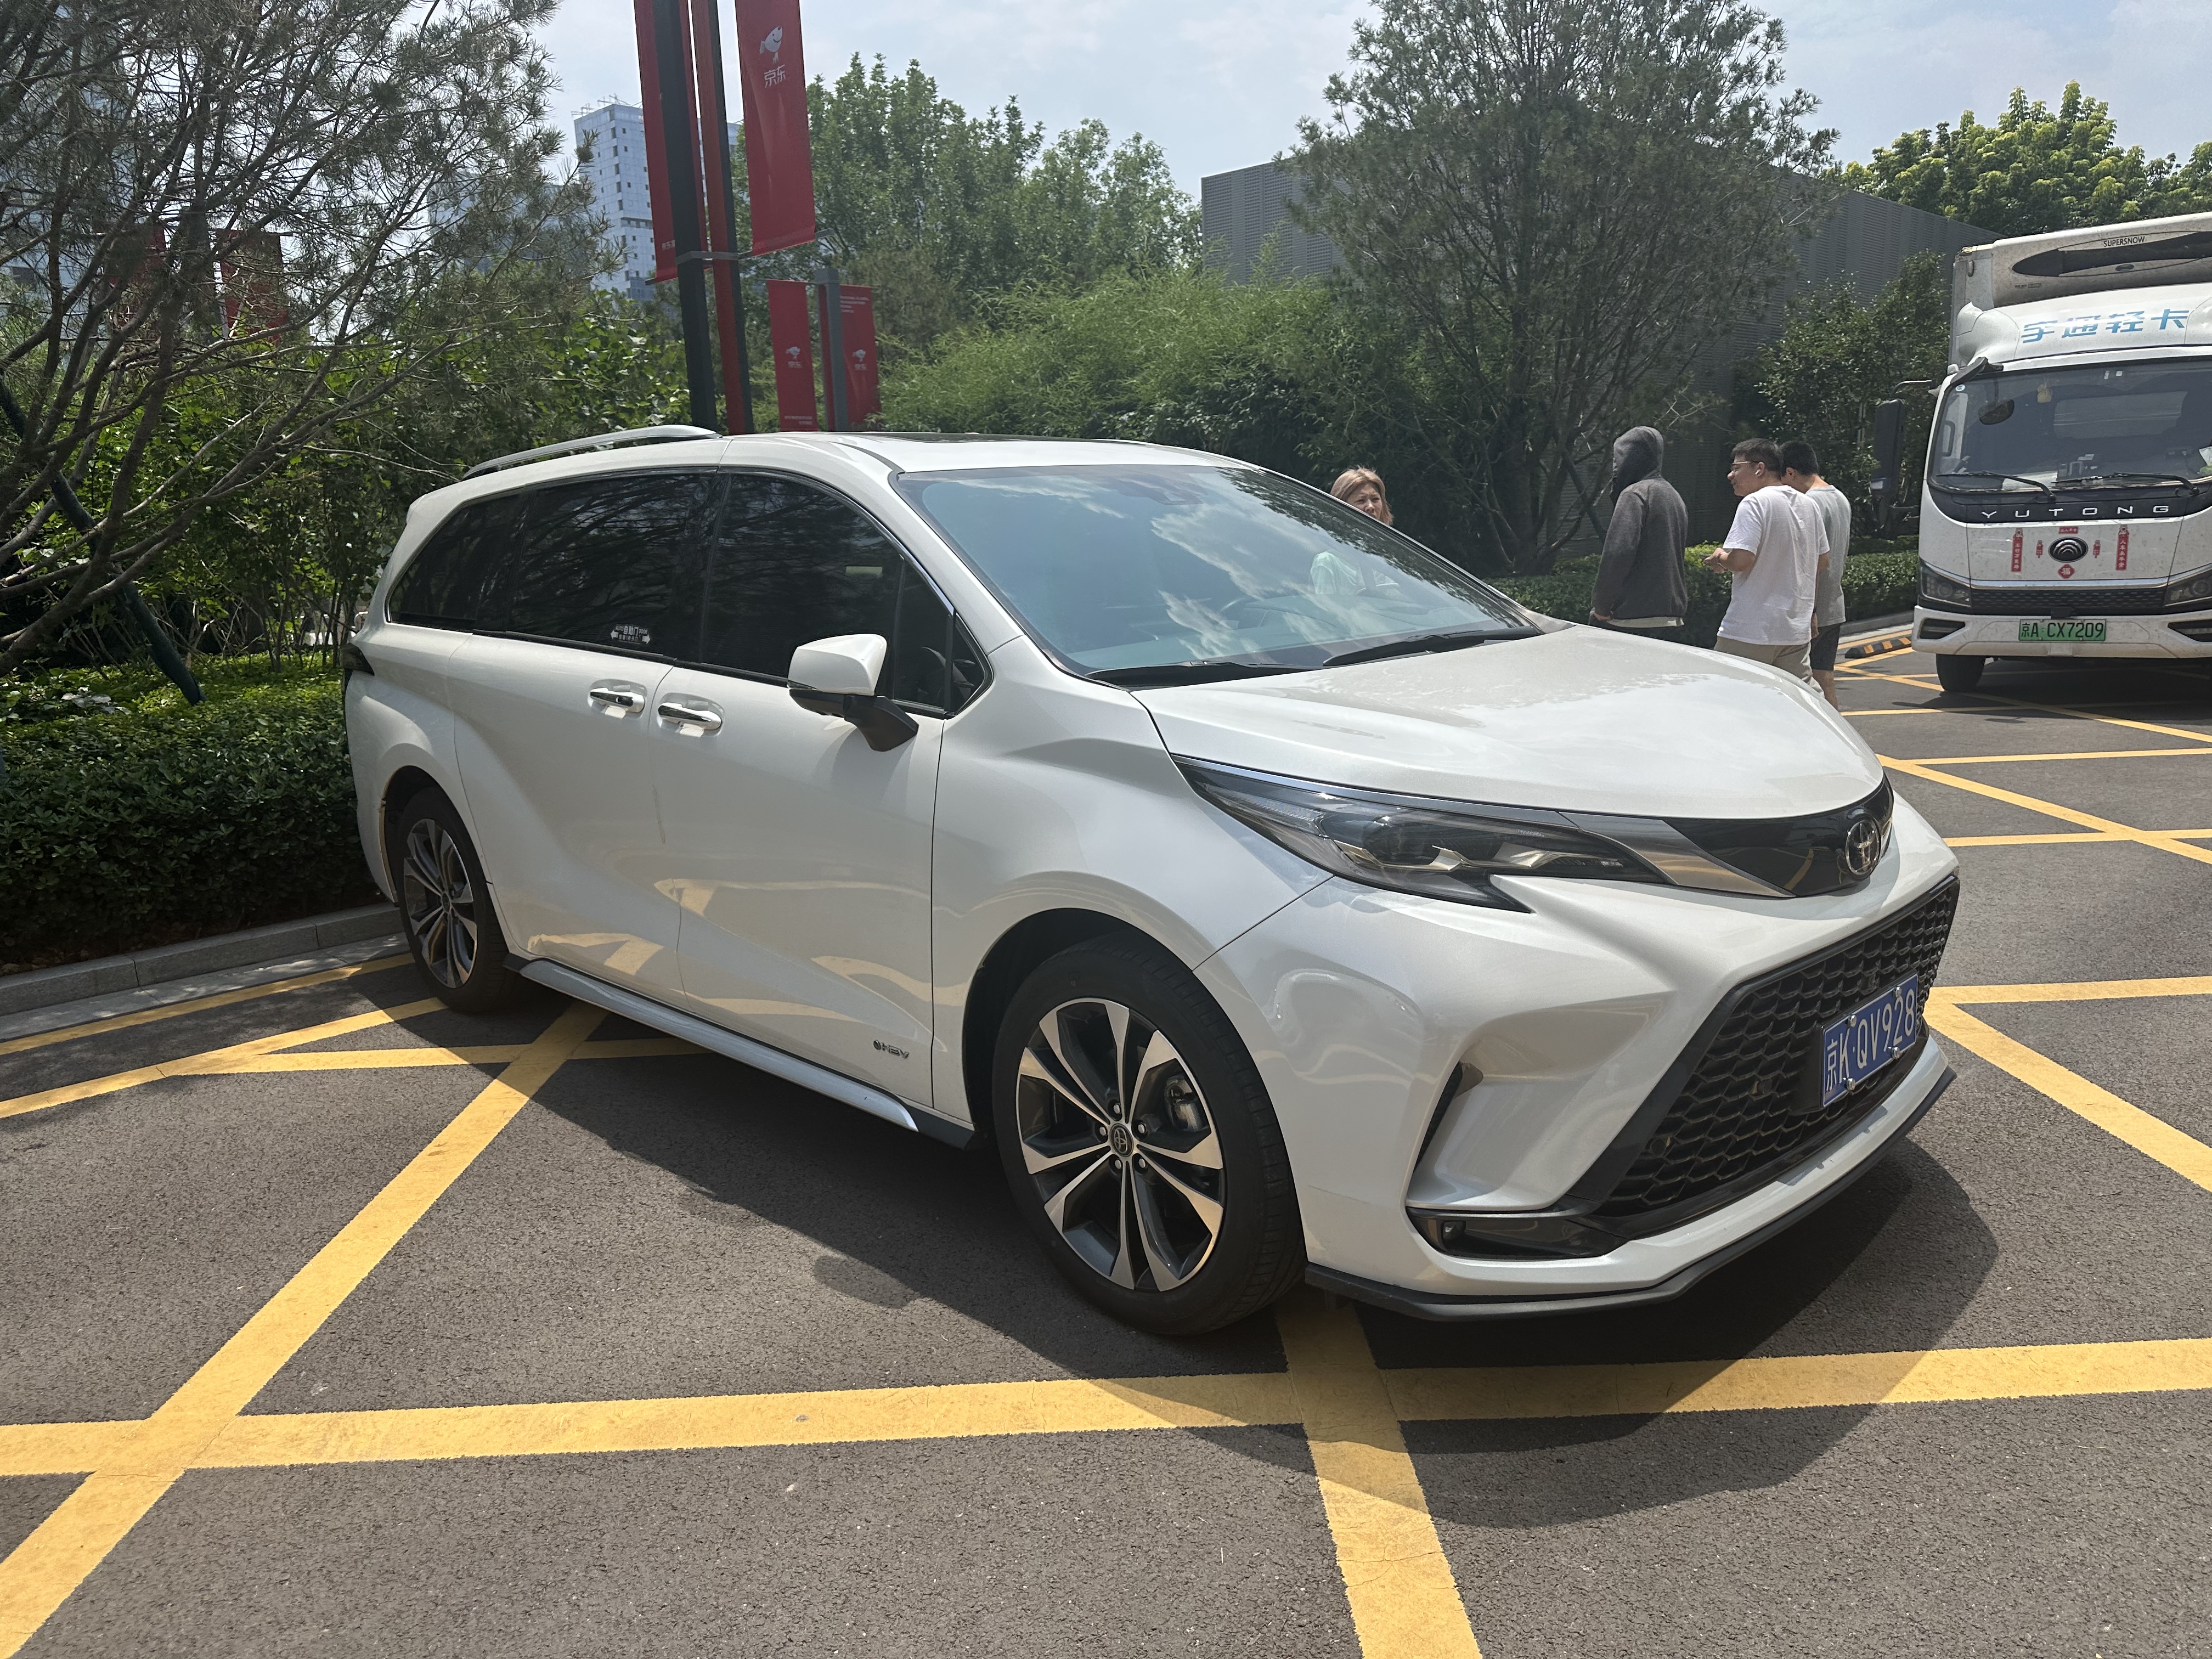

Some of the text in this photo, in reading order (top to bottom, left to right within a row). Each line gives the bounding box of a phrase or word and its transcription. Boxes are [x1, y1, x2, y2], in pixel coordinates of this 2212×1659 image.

[763, 64, 786, 88] 京东
[2103, 236, 2145, 247] SUPERSNOW
[2021, 308, 2189, 343] 宇通轻卡
[1982, 505, 2169, 518] YUTONG
